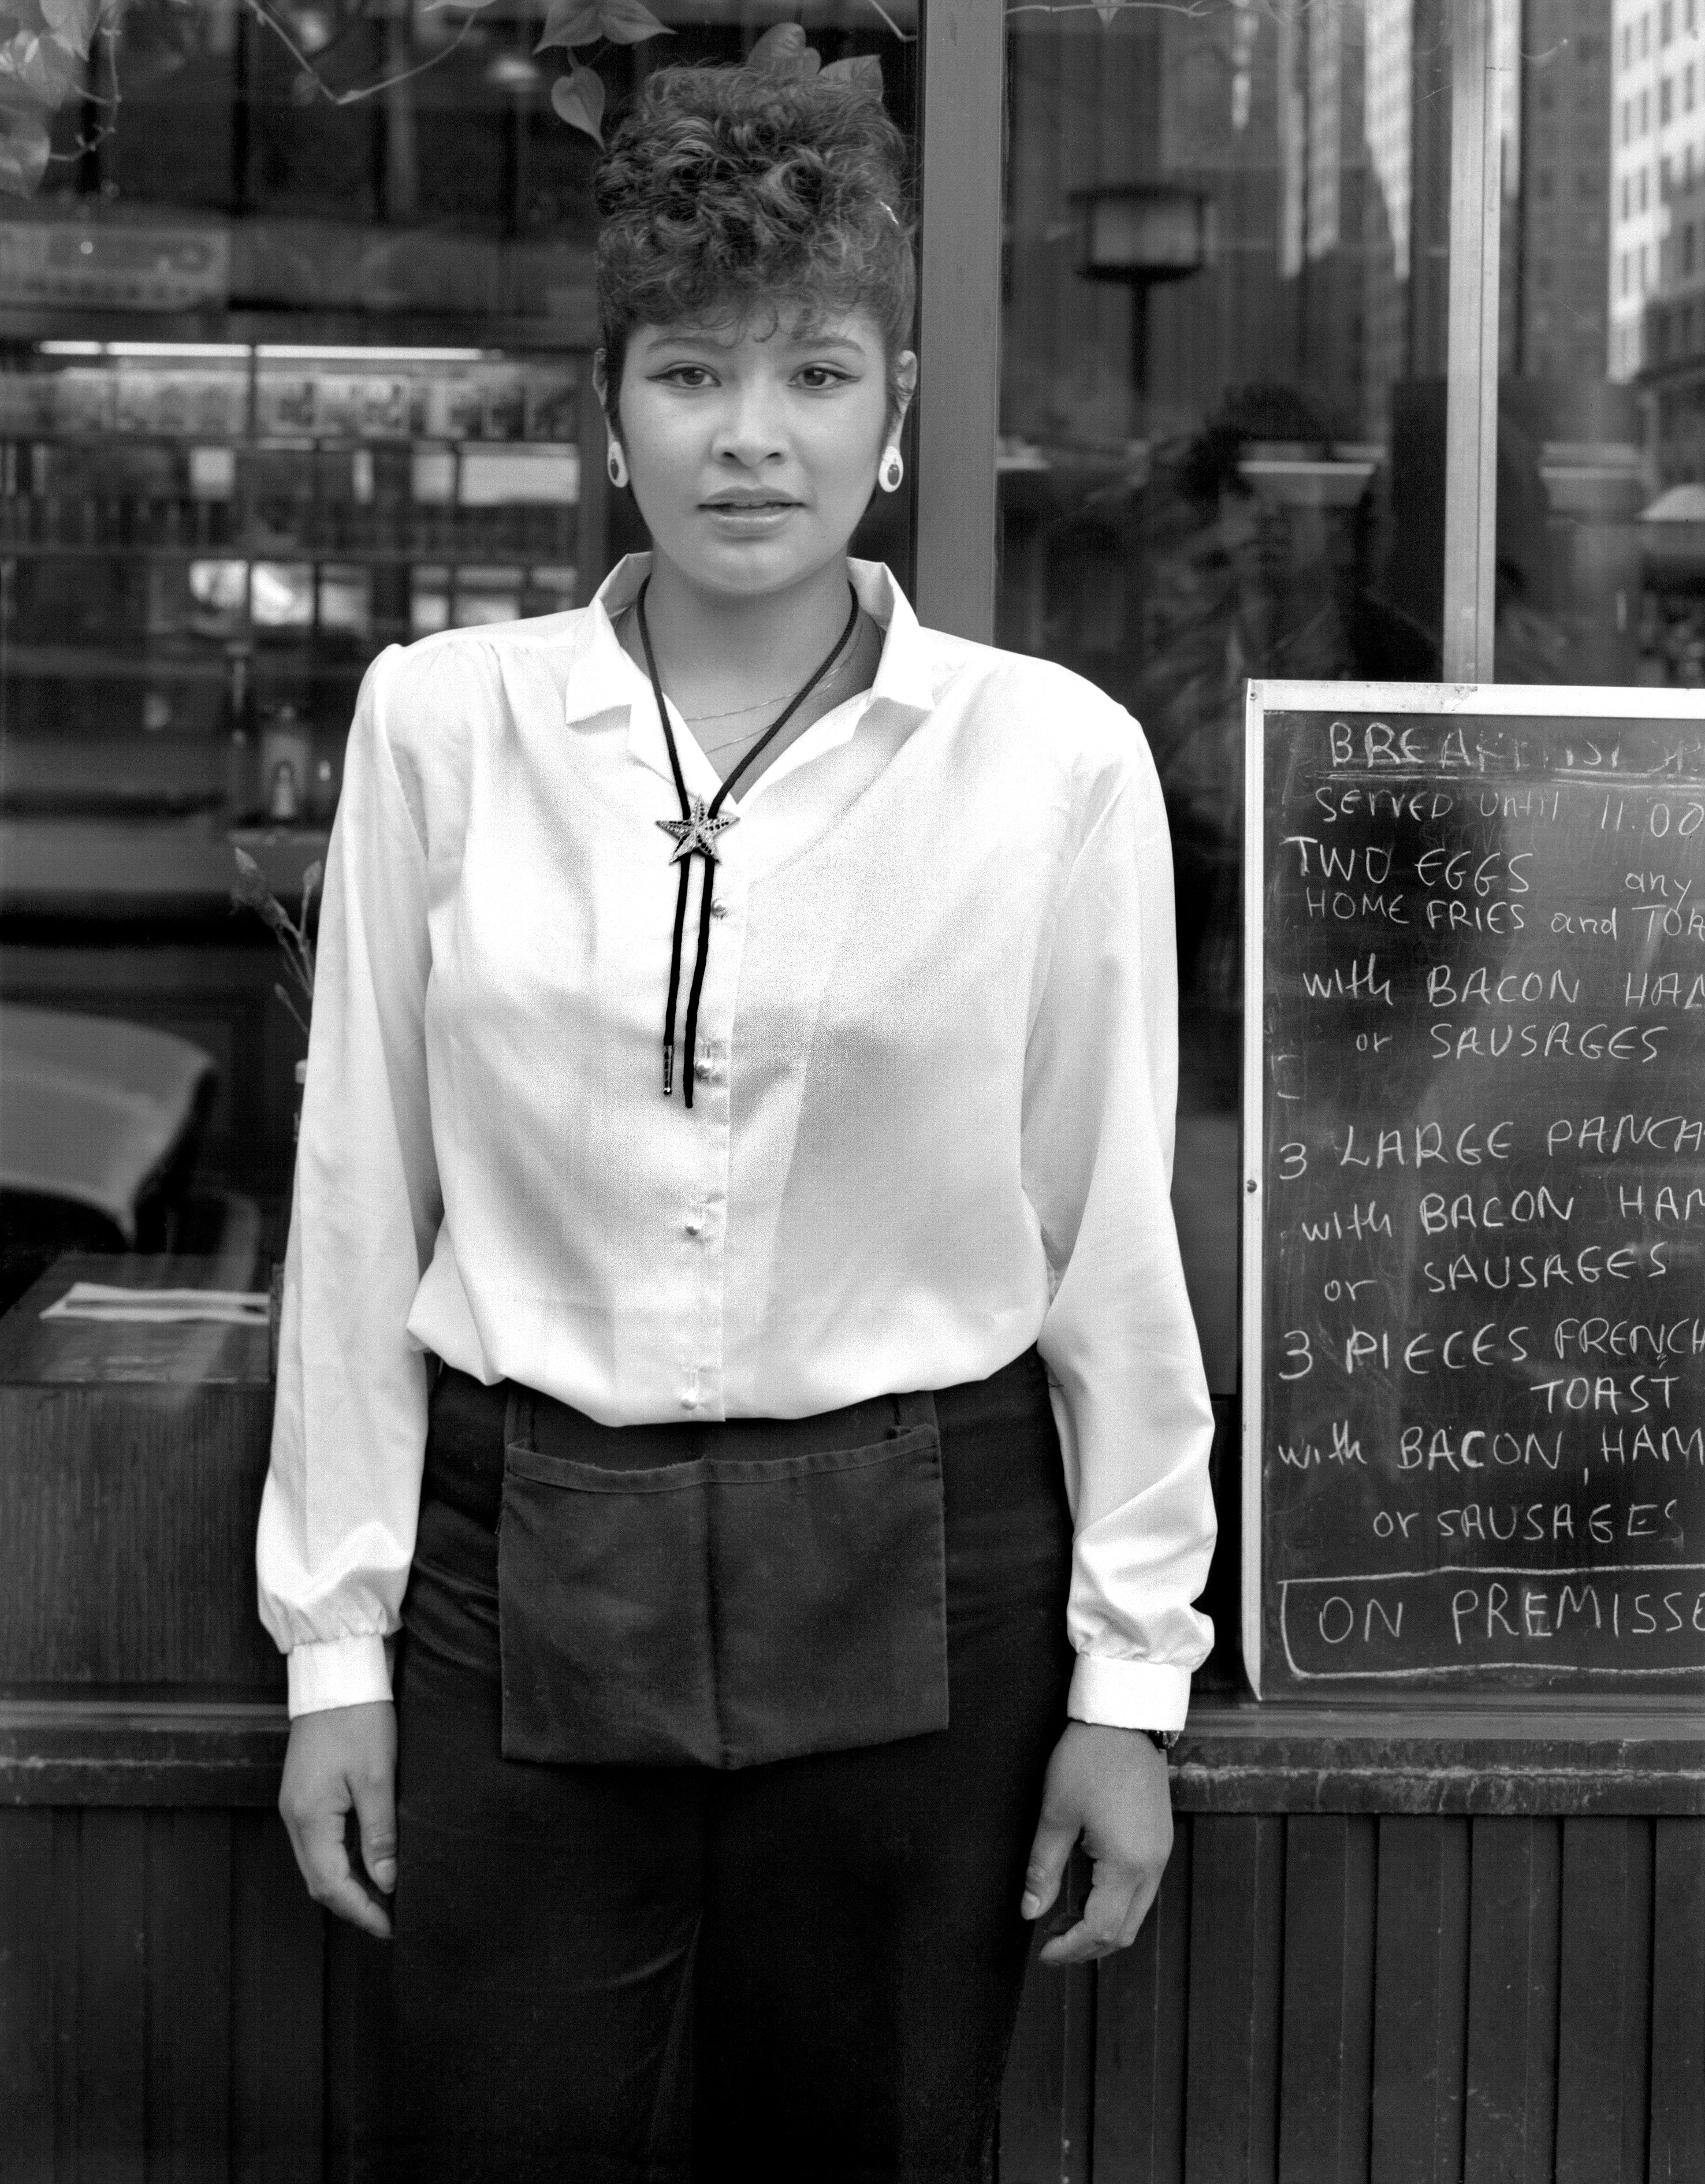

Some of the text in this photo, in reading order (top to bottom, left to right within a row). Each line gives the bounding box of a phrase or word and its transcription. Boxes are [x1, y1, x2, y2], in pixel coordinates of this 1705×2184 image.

[1279, 836, 1692, 914] TWO EGGS any
[1306, 886, 1410, 925] HOME
[1426, 900, 1525, 934] FRIES
[1551, 907, 1617, 942] and
[1302, 953, 1394, 1006] with
[1427, 964, 1580, 1007] BACON
[1356, 1021, 1669, 1064] or SAUSAGES
[1279, 1142, 1308, 1180] 3
[1339, 1121, 1514, 1170] LARGE
[1301, 1200, 1393, 1241] with
[1419, 1186, 1574, 1236] BACON
[1323, 1241, 1669, 1302] or SAUSAGES
[1278, 1317, 1705, 1381] 3 PIECES FRENCH
[1529, 1374, 1681, 1416] TOAST
[1278, 1419, 1369, 1469] with
[1600, 1424, 1705, 1467] HAM
[1372, 1510, 1420, 1538] or
[1318, 1596, 1404, 1644] ON
